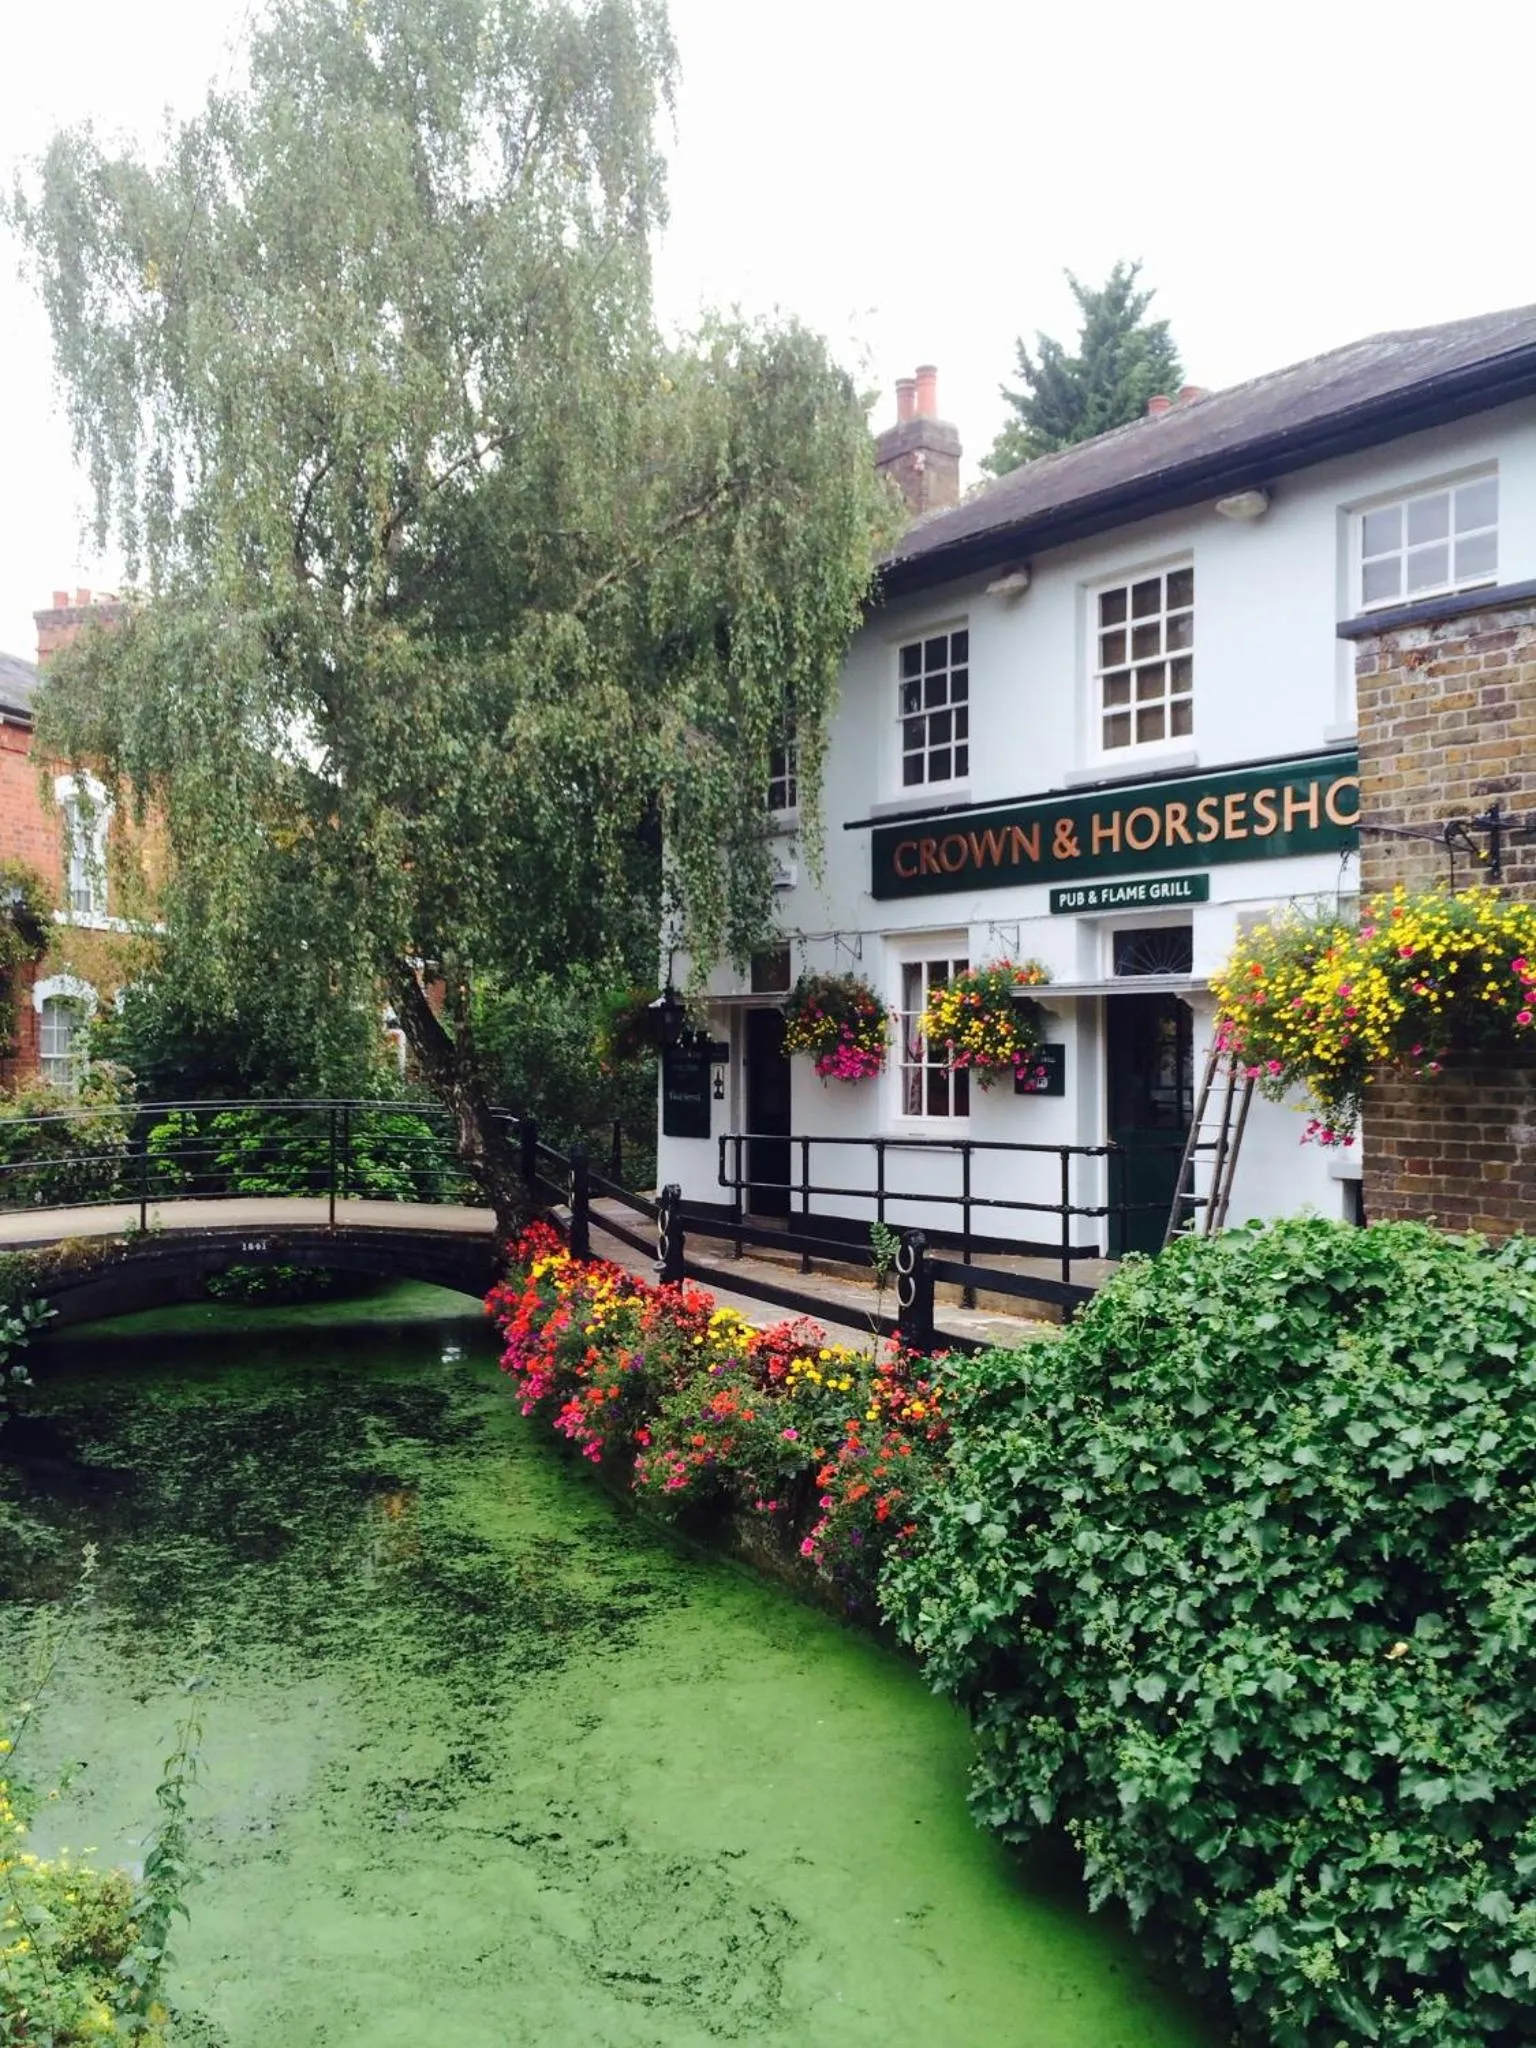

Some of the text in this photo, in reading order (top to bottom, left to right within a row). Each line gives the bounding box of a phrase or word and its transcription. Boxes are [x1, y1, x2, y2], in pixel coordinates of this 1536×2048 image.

[893, 822, 1041, 878] CROWN
[1052, 817, 1082, 860] &
[1059, 881, 1191, 907] PUB & FLAME GRILL
